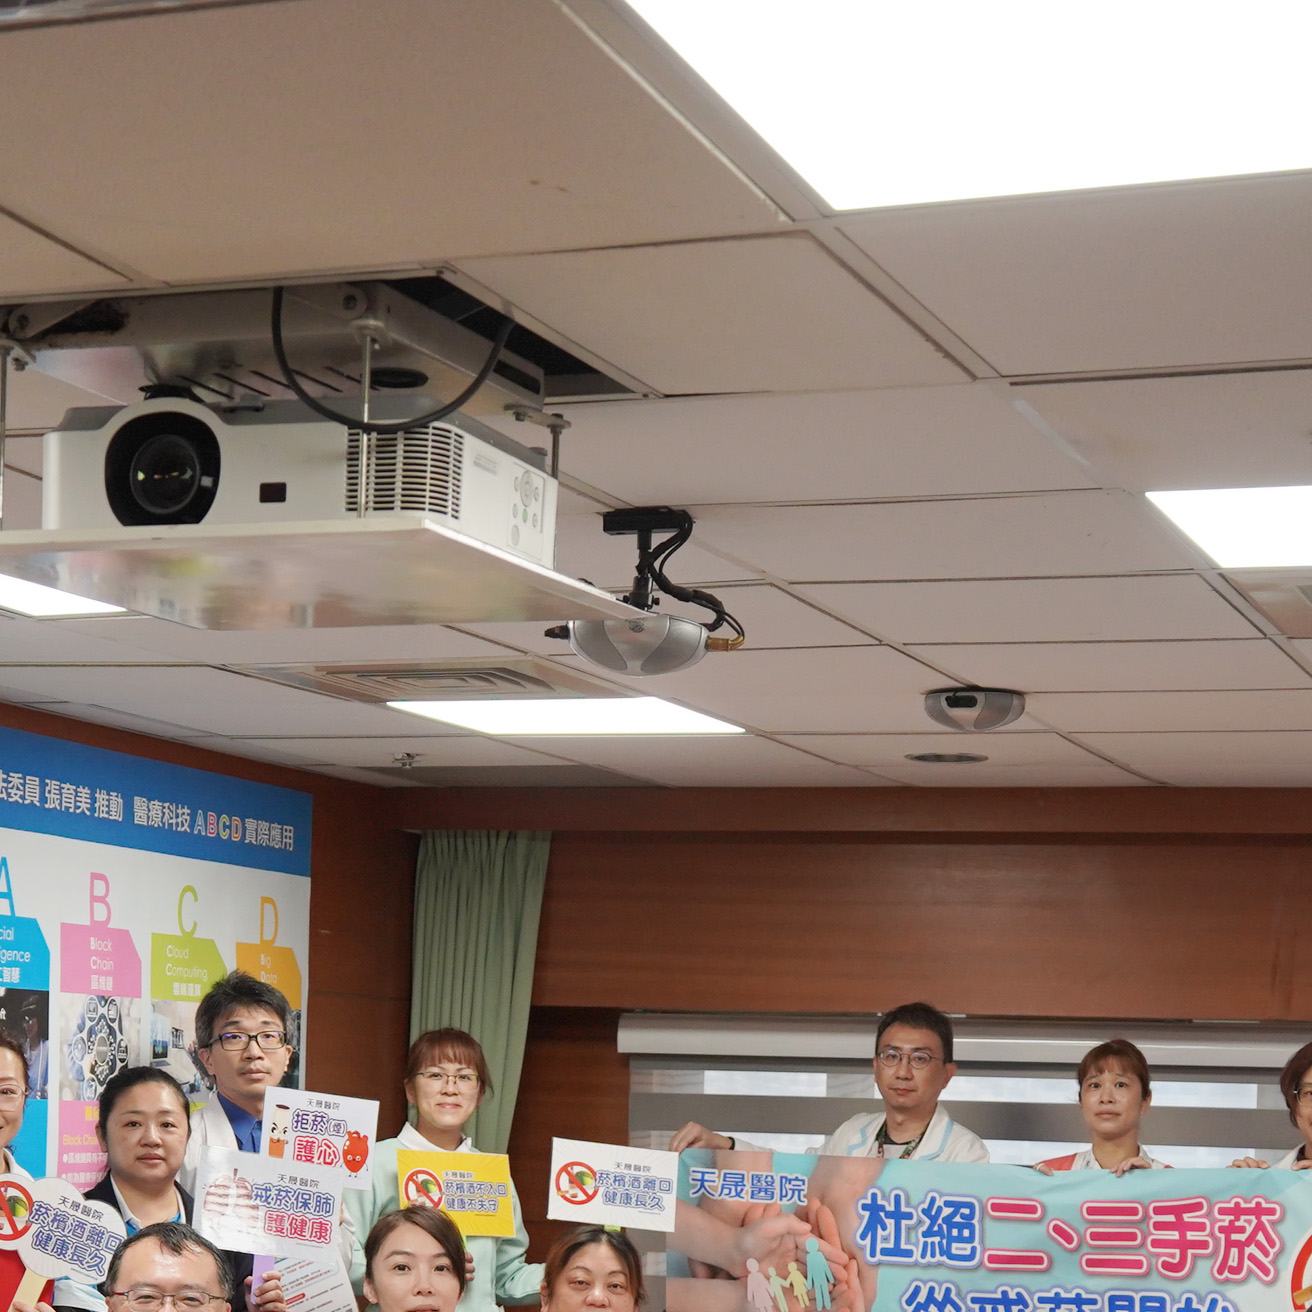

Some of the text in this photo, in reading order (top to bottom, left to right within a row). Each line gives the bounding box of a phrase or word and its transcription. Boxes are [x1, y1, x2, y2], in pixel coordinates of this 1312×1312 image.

[44, 779, 91, 816] 張育美
[94, 788, 123, 822] 推動
[133, 796, 190, 833] 醫療科技
[244, 818, 294, 851] 實際應用
[90, 872, 112, 928] B
[178, 885, 199, 937] C
[260, 896, 279, 946] D
[90, 936, 112, 952] Block
[166, 945, 189, 959] Cloud
[90, 956, 114, 971] Chain
[165, 963, 208, 981] Computing
[306, 1098, 341, 1111] 天晟醫院
[292, 1108, 347, 1137] 拒菸(煙)
[293, 1135, 340, 1168] 護心
[277, 1174, 320, 1190] 天晟醫院
[597, 1170, 673, 1194] 菸檳酒離口
[614, 1162, 652, 1174] 天晟醫院
[251, 1182, 336, 1218] 戒菸保肺
[443, 1179, 508, 1197] 菸檳酒不入口
[688, 1167, 808, 1206] 天晟醫院
[58, 1195, 105, 1223] 天晟醫院
[445, 1197, 499, 1213] 健康不失守
[603, 1190, 665, 1212] 健康長久
[264, 1210, 333, 1244] 護健康
[855, 1185, 1284, 1284] 杜絕二、三手菸
[31, 1228, 106, 1277] 健康長久
